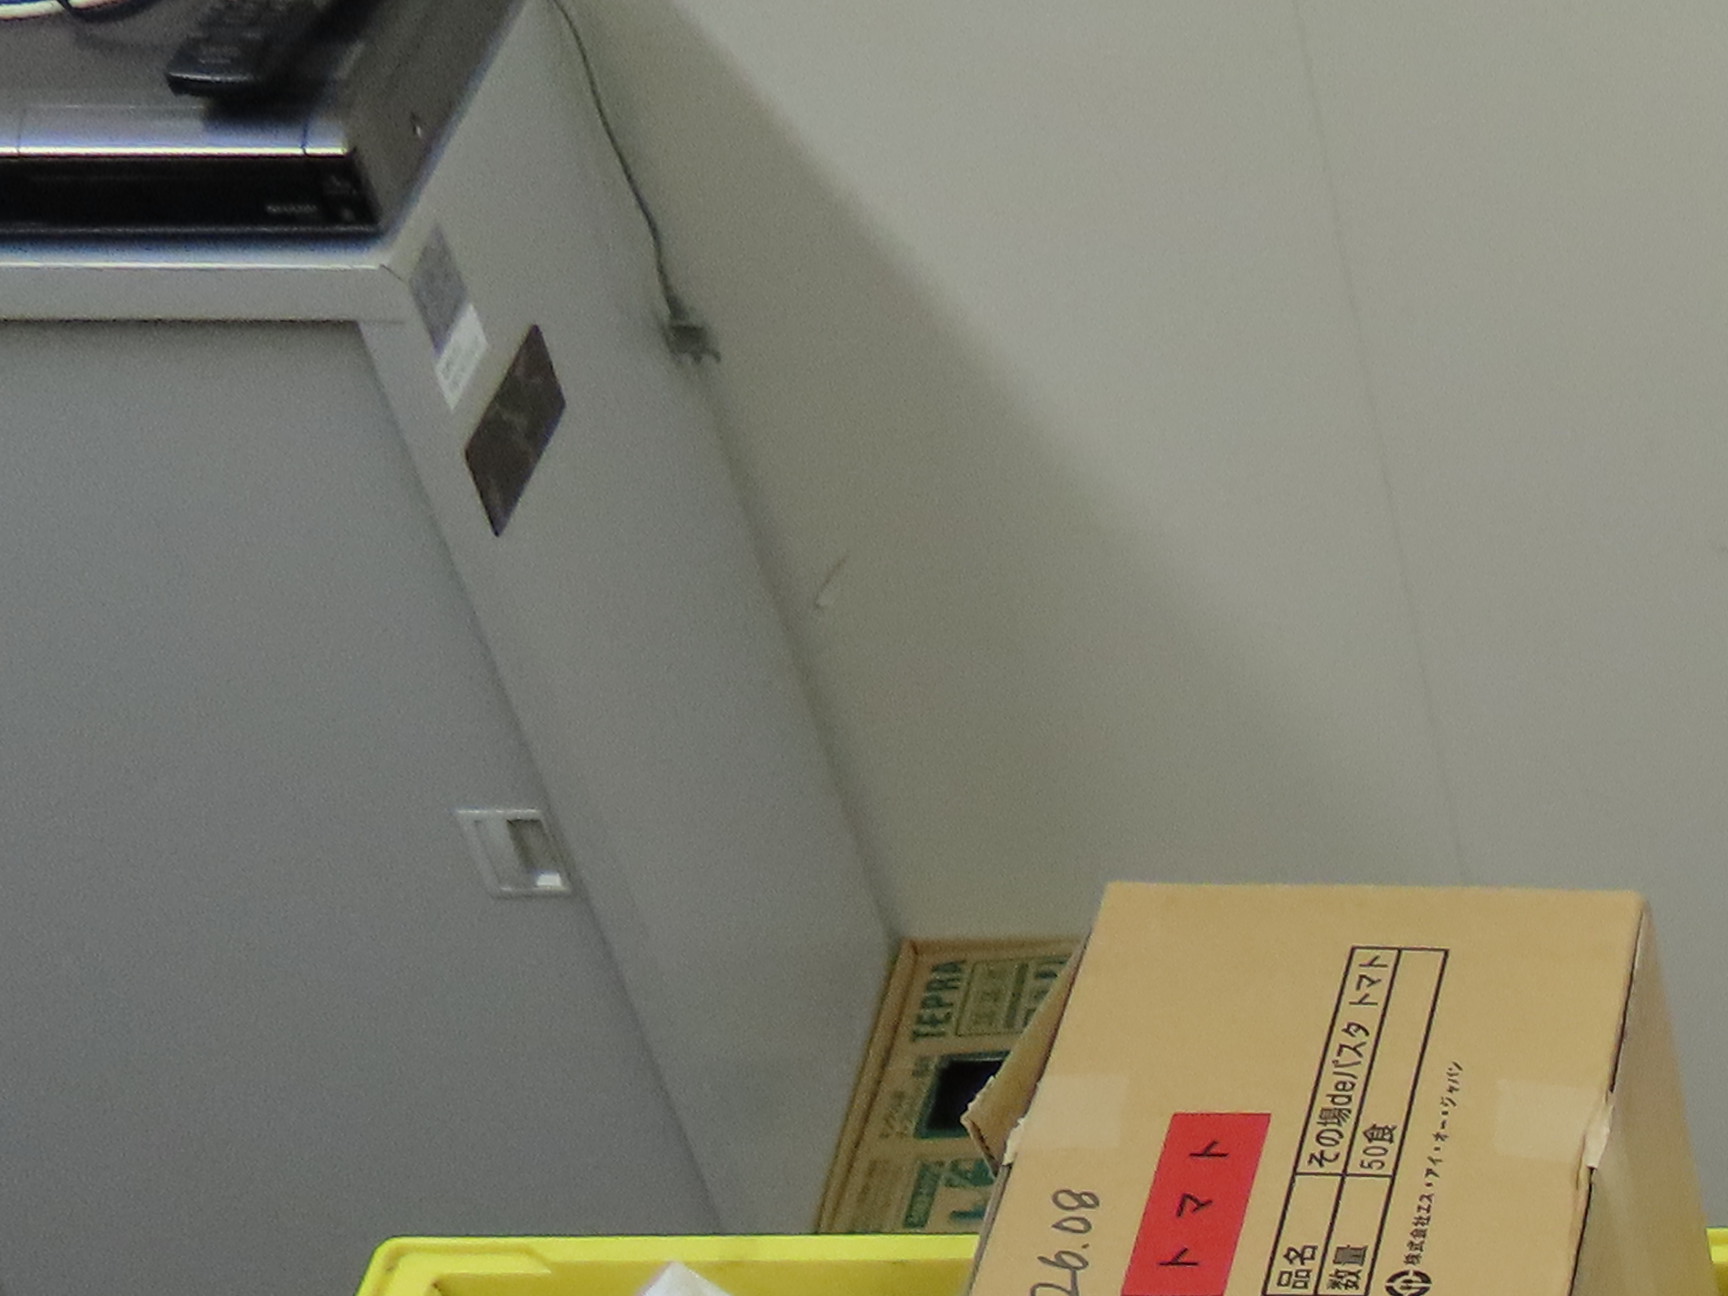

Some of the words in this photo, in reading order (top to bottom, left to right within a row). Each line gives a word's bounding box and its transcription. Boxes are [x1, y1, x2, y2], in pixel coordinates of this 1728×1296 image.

[912, 958, 968, 1043] TEPRA
[1306, 1020, 1372, 1170] その場deパスタ
[1355, 952, 1391, 1011] トマト
[1360, 1121, 1399, 1172] 50食
[1157, 1139, 1229, 1269] トマト
[1276, 1242, 1321, 1293] 品名
[1327, 1243, 1368, 1293] 数量
